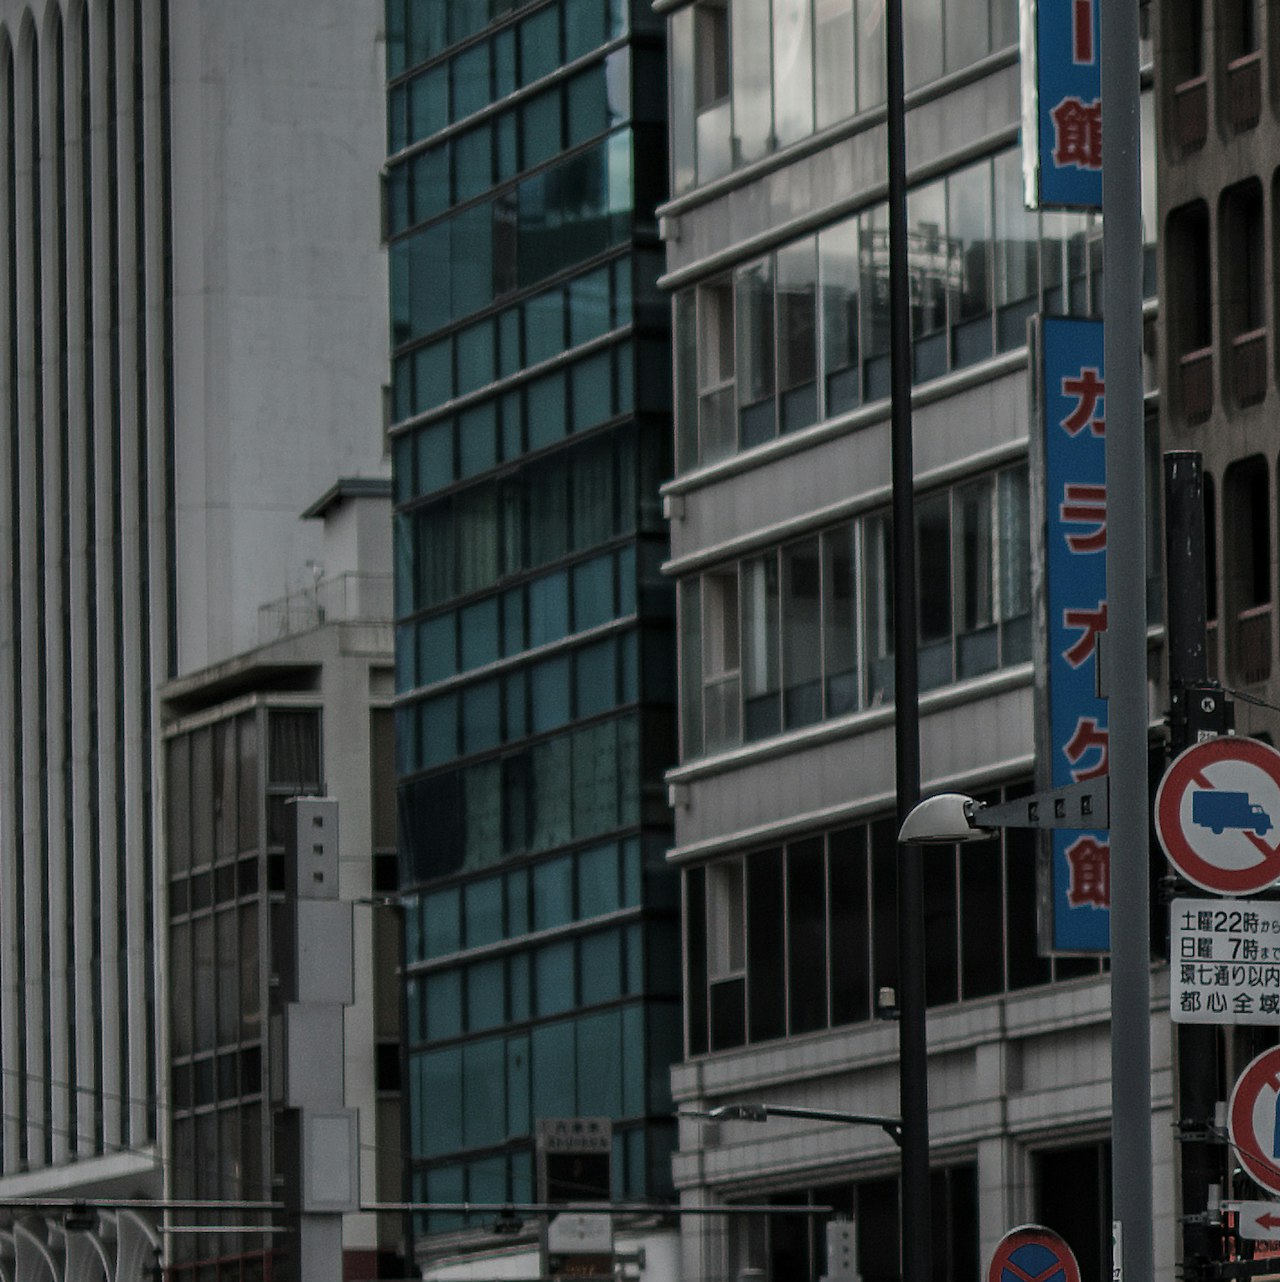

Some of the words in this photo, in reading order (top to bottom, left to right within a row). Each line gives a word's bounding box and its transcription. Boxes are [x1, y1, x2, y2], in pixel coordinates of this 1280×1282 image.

[1180, 964, 1280, 988] 環七通り以内
[1180, 990, 1280, 1015] 都心全域
